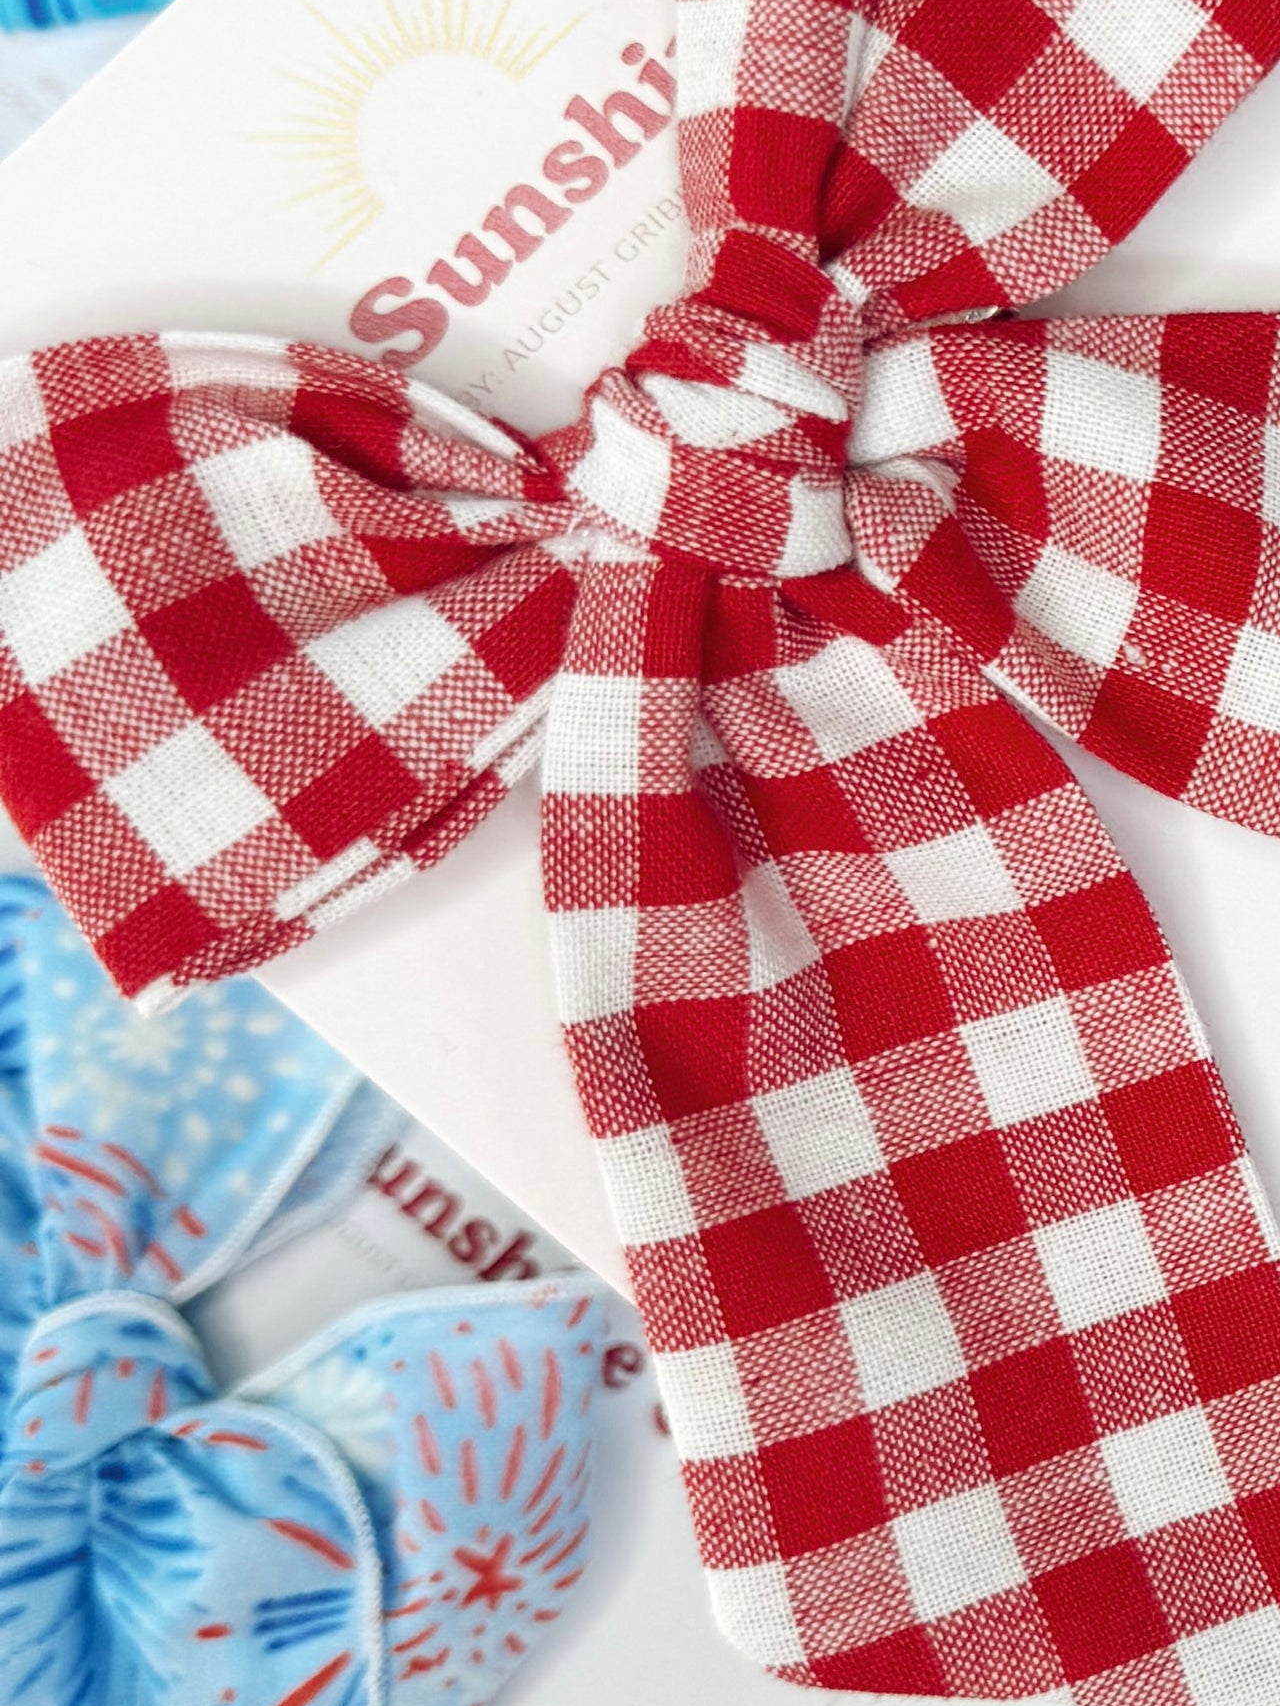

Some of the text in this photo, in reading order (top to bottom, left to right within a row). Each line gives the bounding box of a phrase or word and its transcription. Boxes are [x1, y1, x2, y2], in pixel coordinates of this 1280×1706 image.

[348, 36, 678, 371] Sunshi
[502, 258, 612, 373] AUGUST
[614, 186, 683, 263] GRIB
